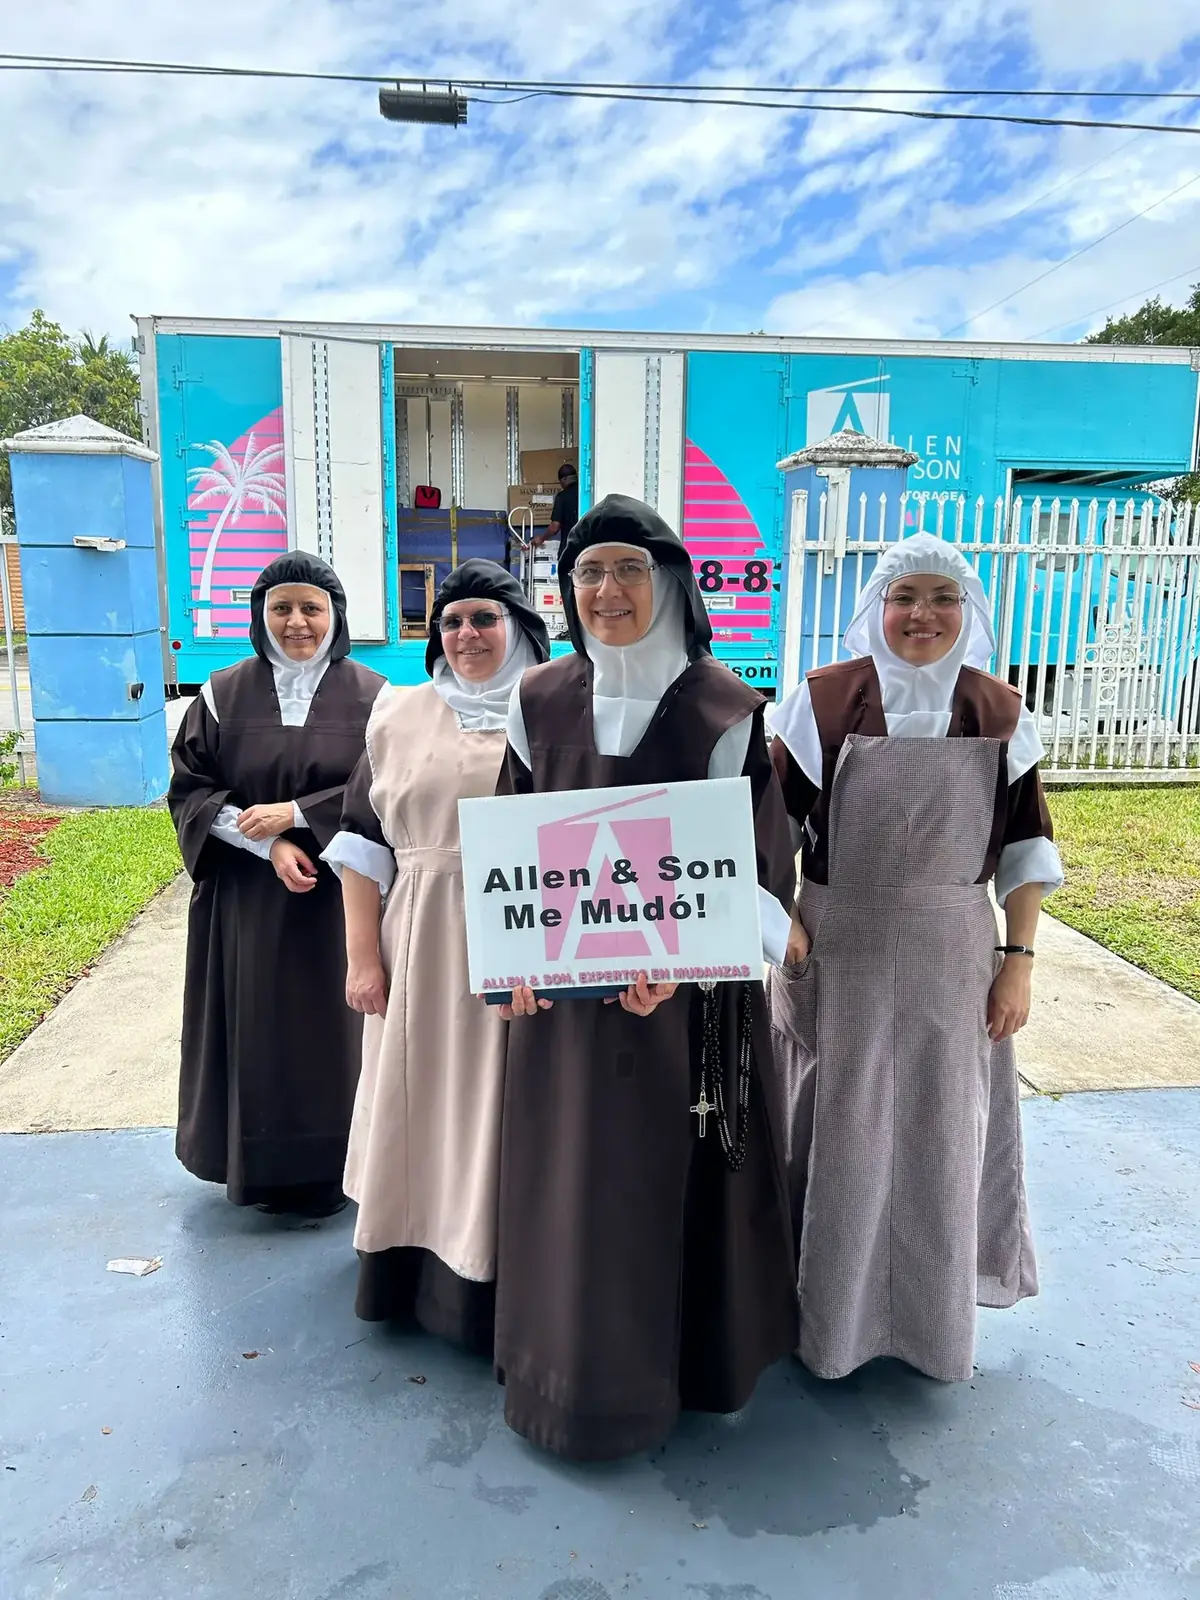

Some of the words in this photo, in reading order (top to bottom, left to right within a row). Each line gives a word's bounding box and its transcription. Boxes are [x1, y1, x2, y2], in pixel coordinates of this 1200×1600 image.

[913, 459, 960, 480] SON
[483, 865, 591, 893] Allen
[611, 858, 639, 884] &
[657, 855, 737, 882] Son
[504, 903, 562, 930] Me
[580, 893, 706, 925] Mudó!
[482, 975, 526, 989] ALLEN
[529, 974, 539, 986] &
[543, 972, 576, 986] SON,
[651, 968, 671, 981] EN
[673, 964, 751, 980] MUDANZAS
